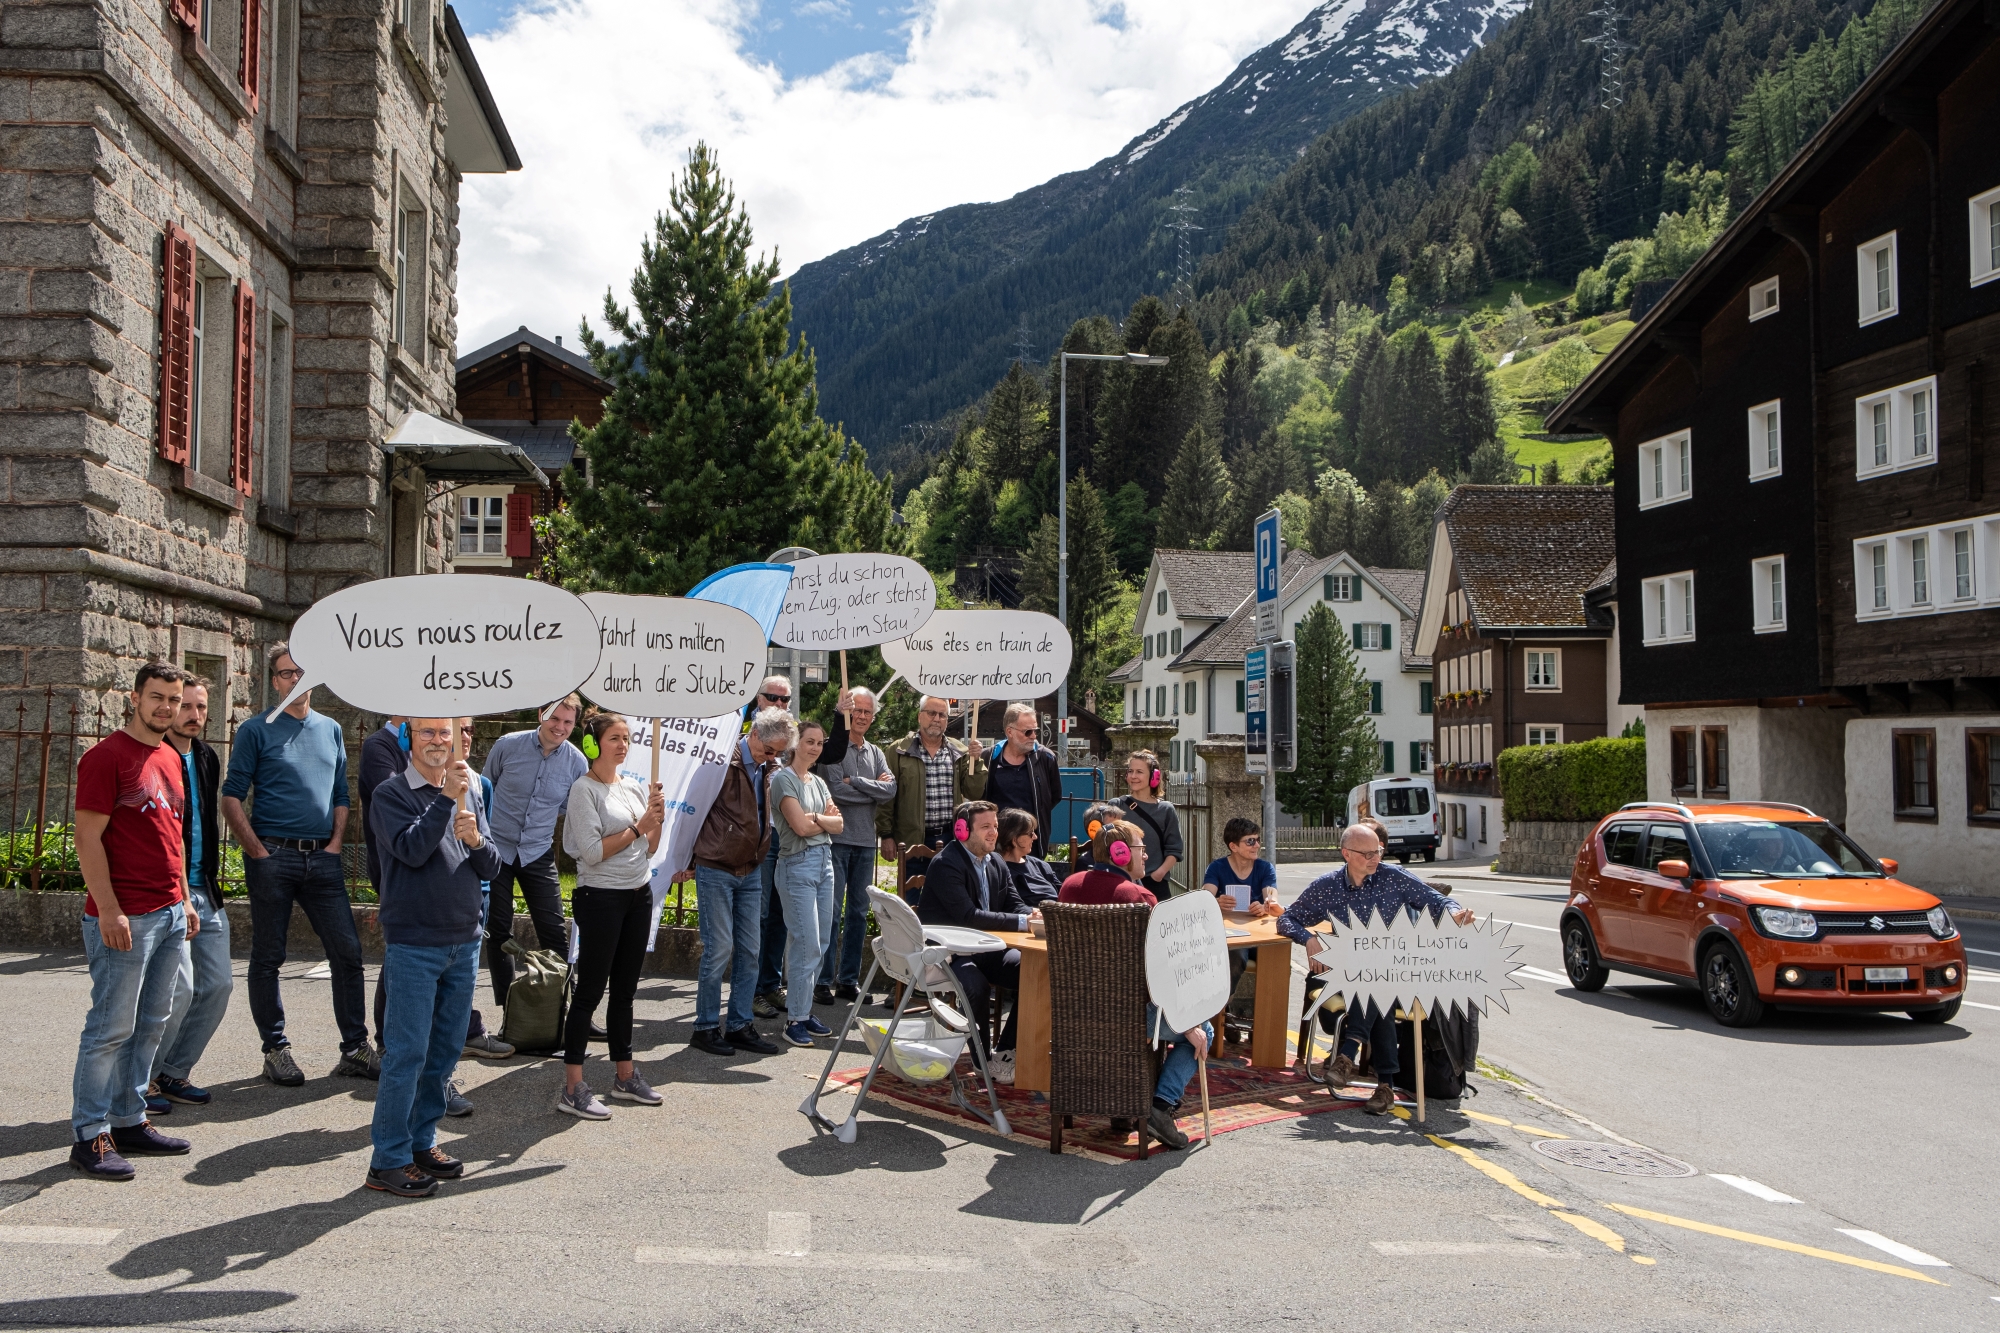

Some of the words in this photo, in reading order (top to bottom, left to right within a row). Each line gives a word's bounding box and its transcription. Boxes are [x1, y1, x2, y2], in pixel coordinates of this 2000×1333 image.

[1260, 529, 1271, 590] P
[787, 564, 823, 591] hrst
[828, 561, 850, 585] du
[854, 561, 905, 583] schon
[848, 589, 880, 607] oder
[886, 580, 928, 603] stehst
[336, 612, 404, 652] Vous
[417, 622, 477, 646] nous
[484, 604, 563, 642] roulez
[646, 630, 674, 651] uns
[679, 621, 725, 653] mitten
[786, 621, 805, 644] du
[812, 619, 847, 643] noch
[851, 616, 870, 638] im
[902, 634, 934, 652] Vous
[943, 631, 970, 652] êtes
[976, 638, 992, 652] en
[999, 630, 1032, 652] train
[1036, 631, 1053, 652] de
[423, 654, 514, 691] dessus
[603, 661, 642, 693] durch
[655, 664, 677, 693] die
[685, 660, 755, 697] Stube!
[918, 664, 978, 686] traverser
[982, 664, 1013, 687] notre
[1016, 663, 1052, 687] salon
[630, 727, 653, 747] da
[660, 732, 686, 755] las
[690, 741, 727, 767] alps
